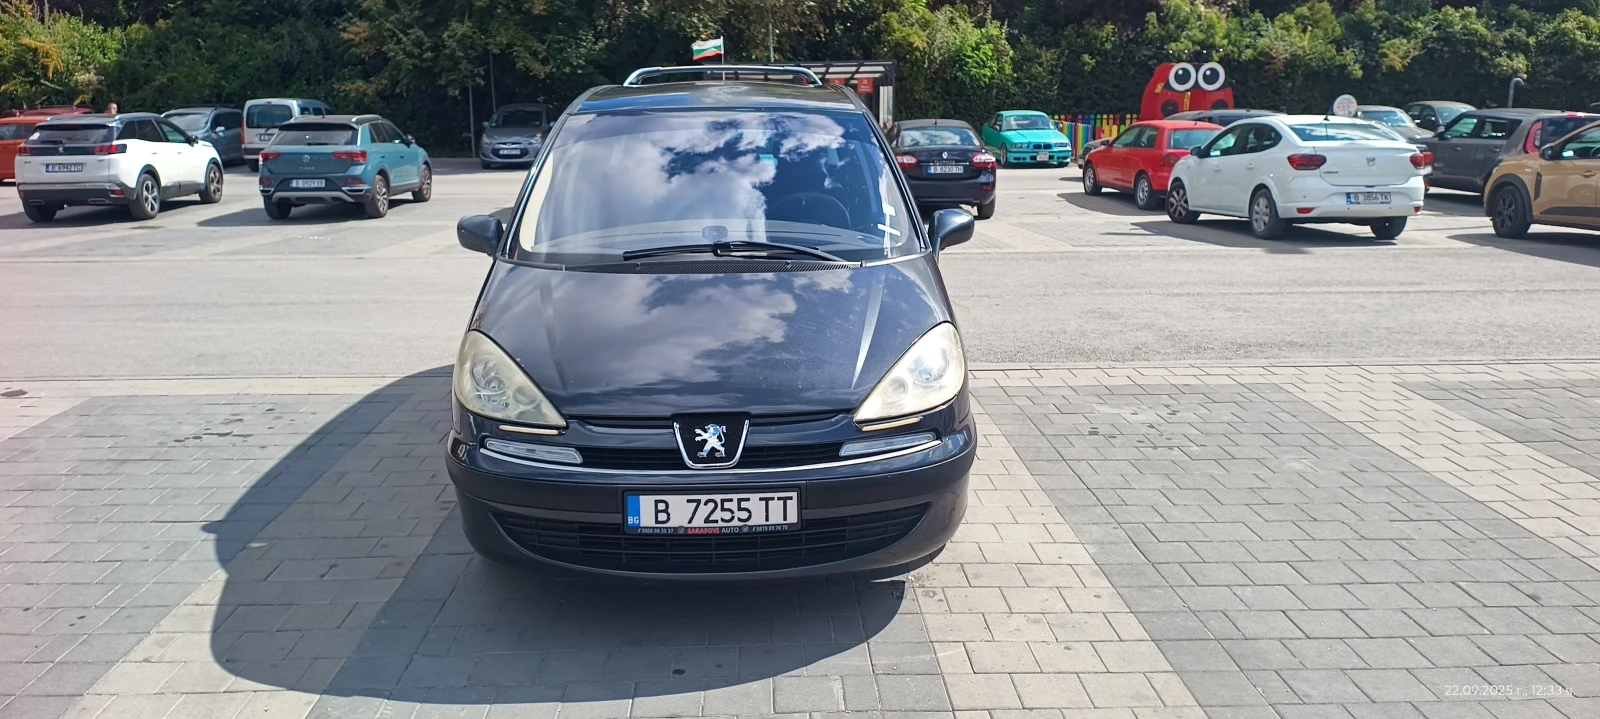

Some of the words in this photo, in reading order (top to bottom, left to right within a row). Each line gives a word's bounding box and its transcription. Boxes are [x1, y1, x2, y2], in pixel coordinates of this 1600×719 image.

[654, 499, 671, 525] B
[686, 497, 753, 525] 7255
[759, 496, 793, 522] TT
[628, 516, 640, 524] BG
